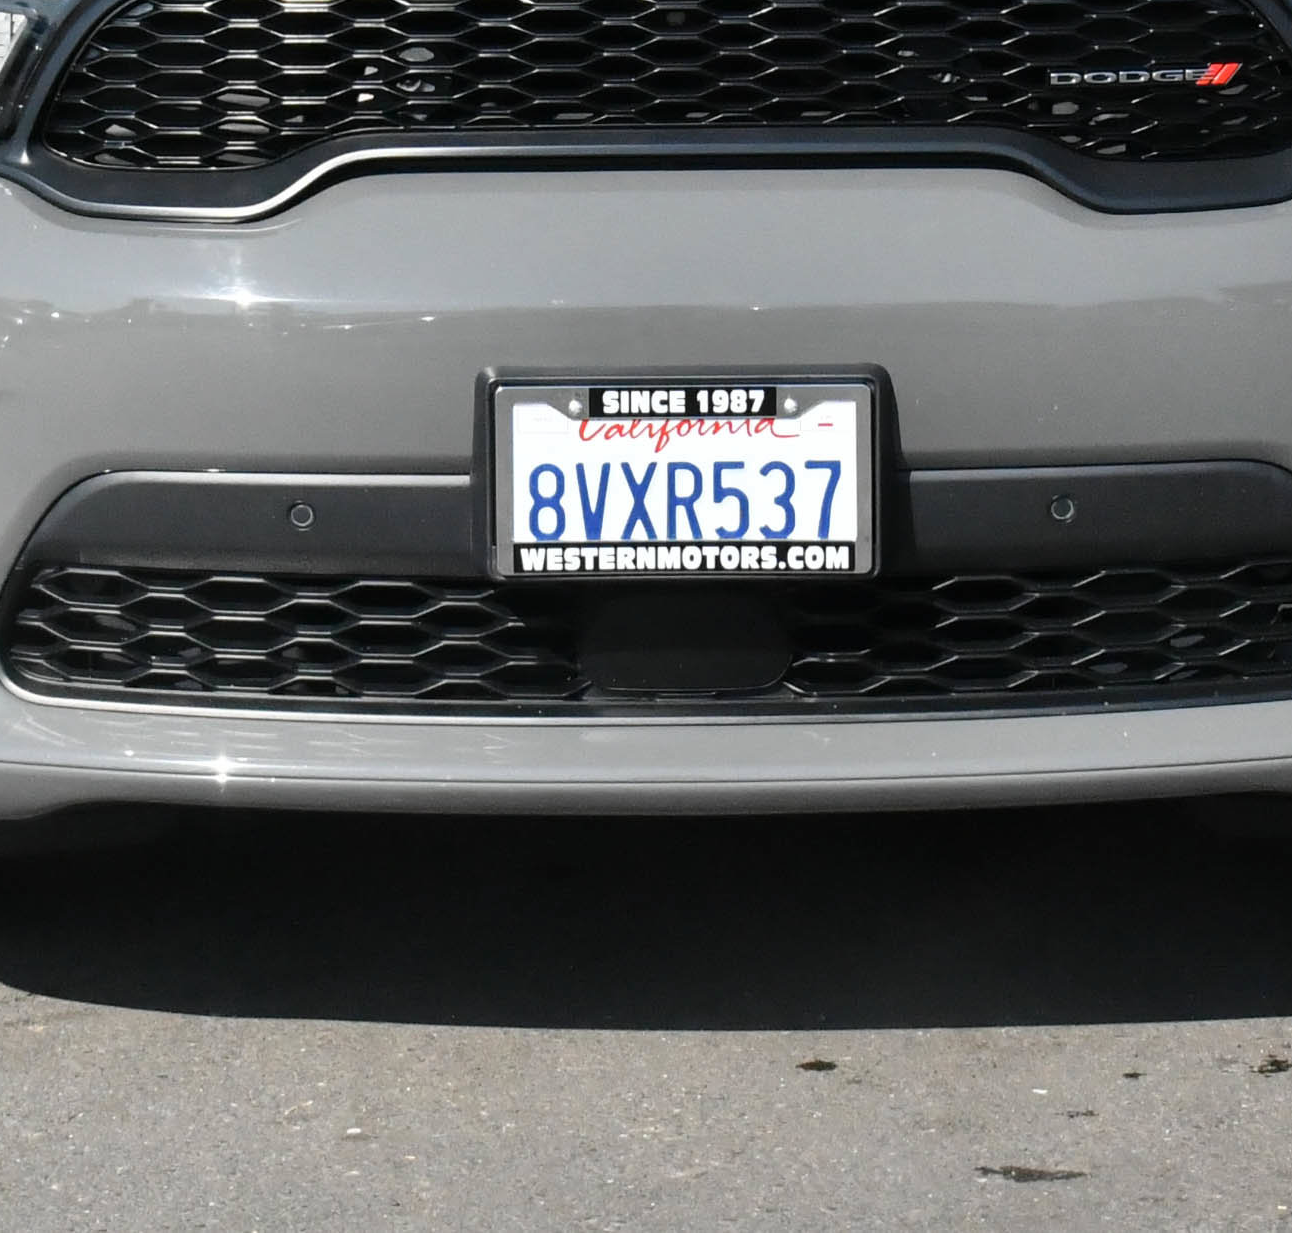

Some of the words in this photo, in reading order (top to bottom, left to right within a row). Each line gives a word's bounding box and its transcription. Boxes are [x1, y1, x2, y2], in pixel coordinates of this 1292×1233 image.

[1050, 68, 1214, 85] DODGE
[602, 390, 686, 414] SINCE
[696, 389, 765, 414] 1987
[528, 460, 842, 540] 8VXR537
[520, 545, 850, 572] WESTERNMOTORS.COM
